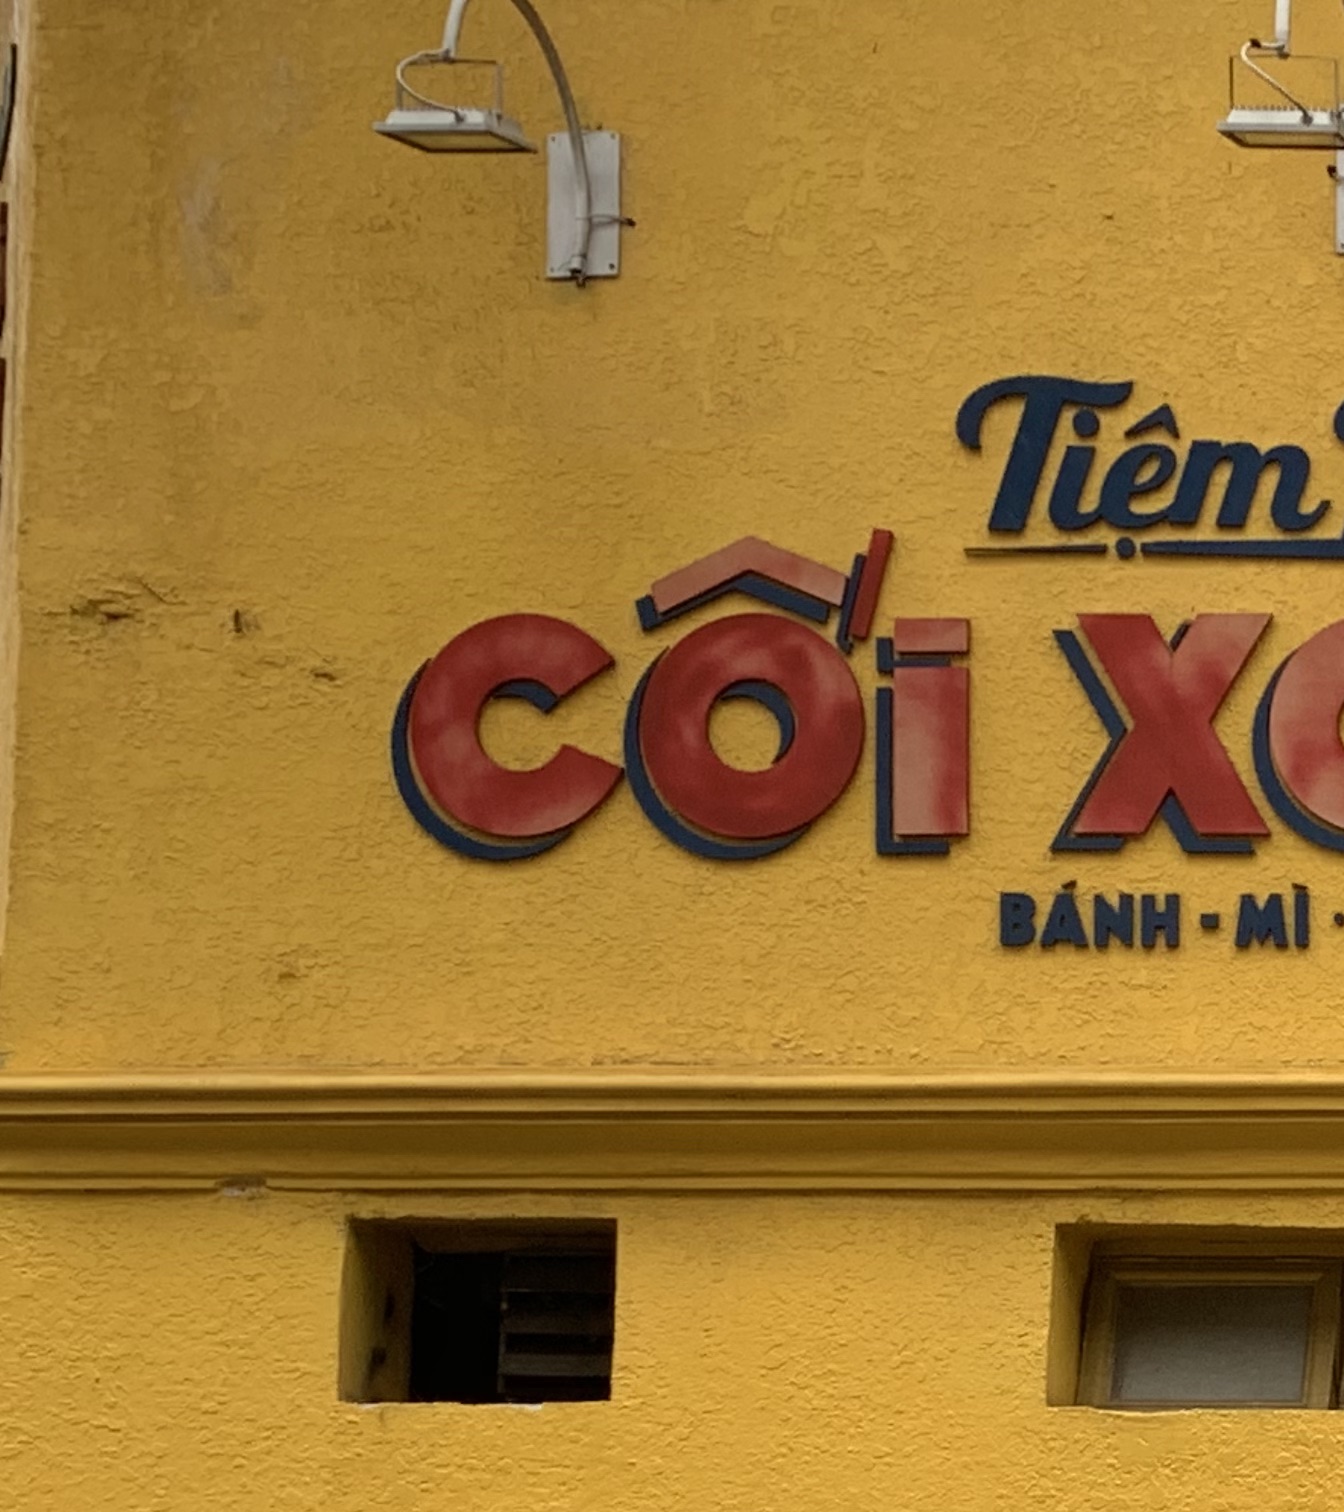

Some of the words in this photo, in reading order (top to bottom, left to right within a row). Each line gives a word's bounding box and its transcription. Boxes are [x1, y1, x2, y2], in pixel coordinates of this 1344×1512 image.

[956, 375, 1331, 561] Tiệm
[1000, 880, 1181, 949] BÁNH
[1235, 882, 1310, 949] MÌ
